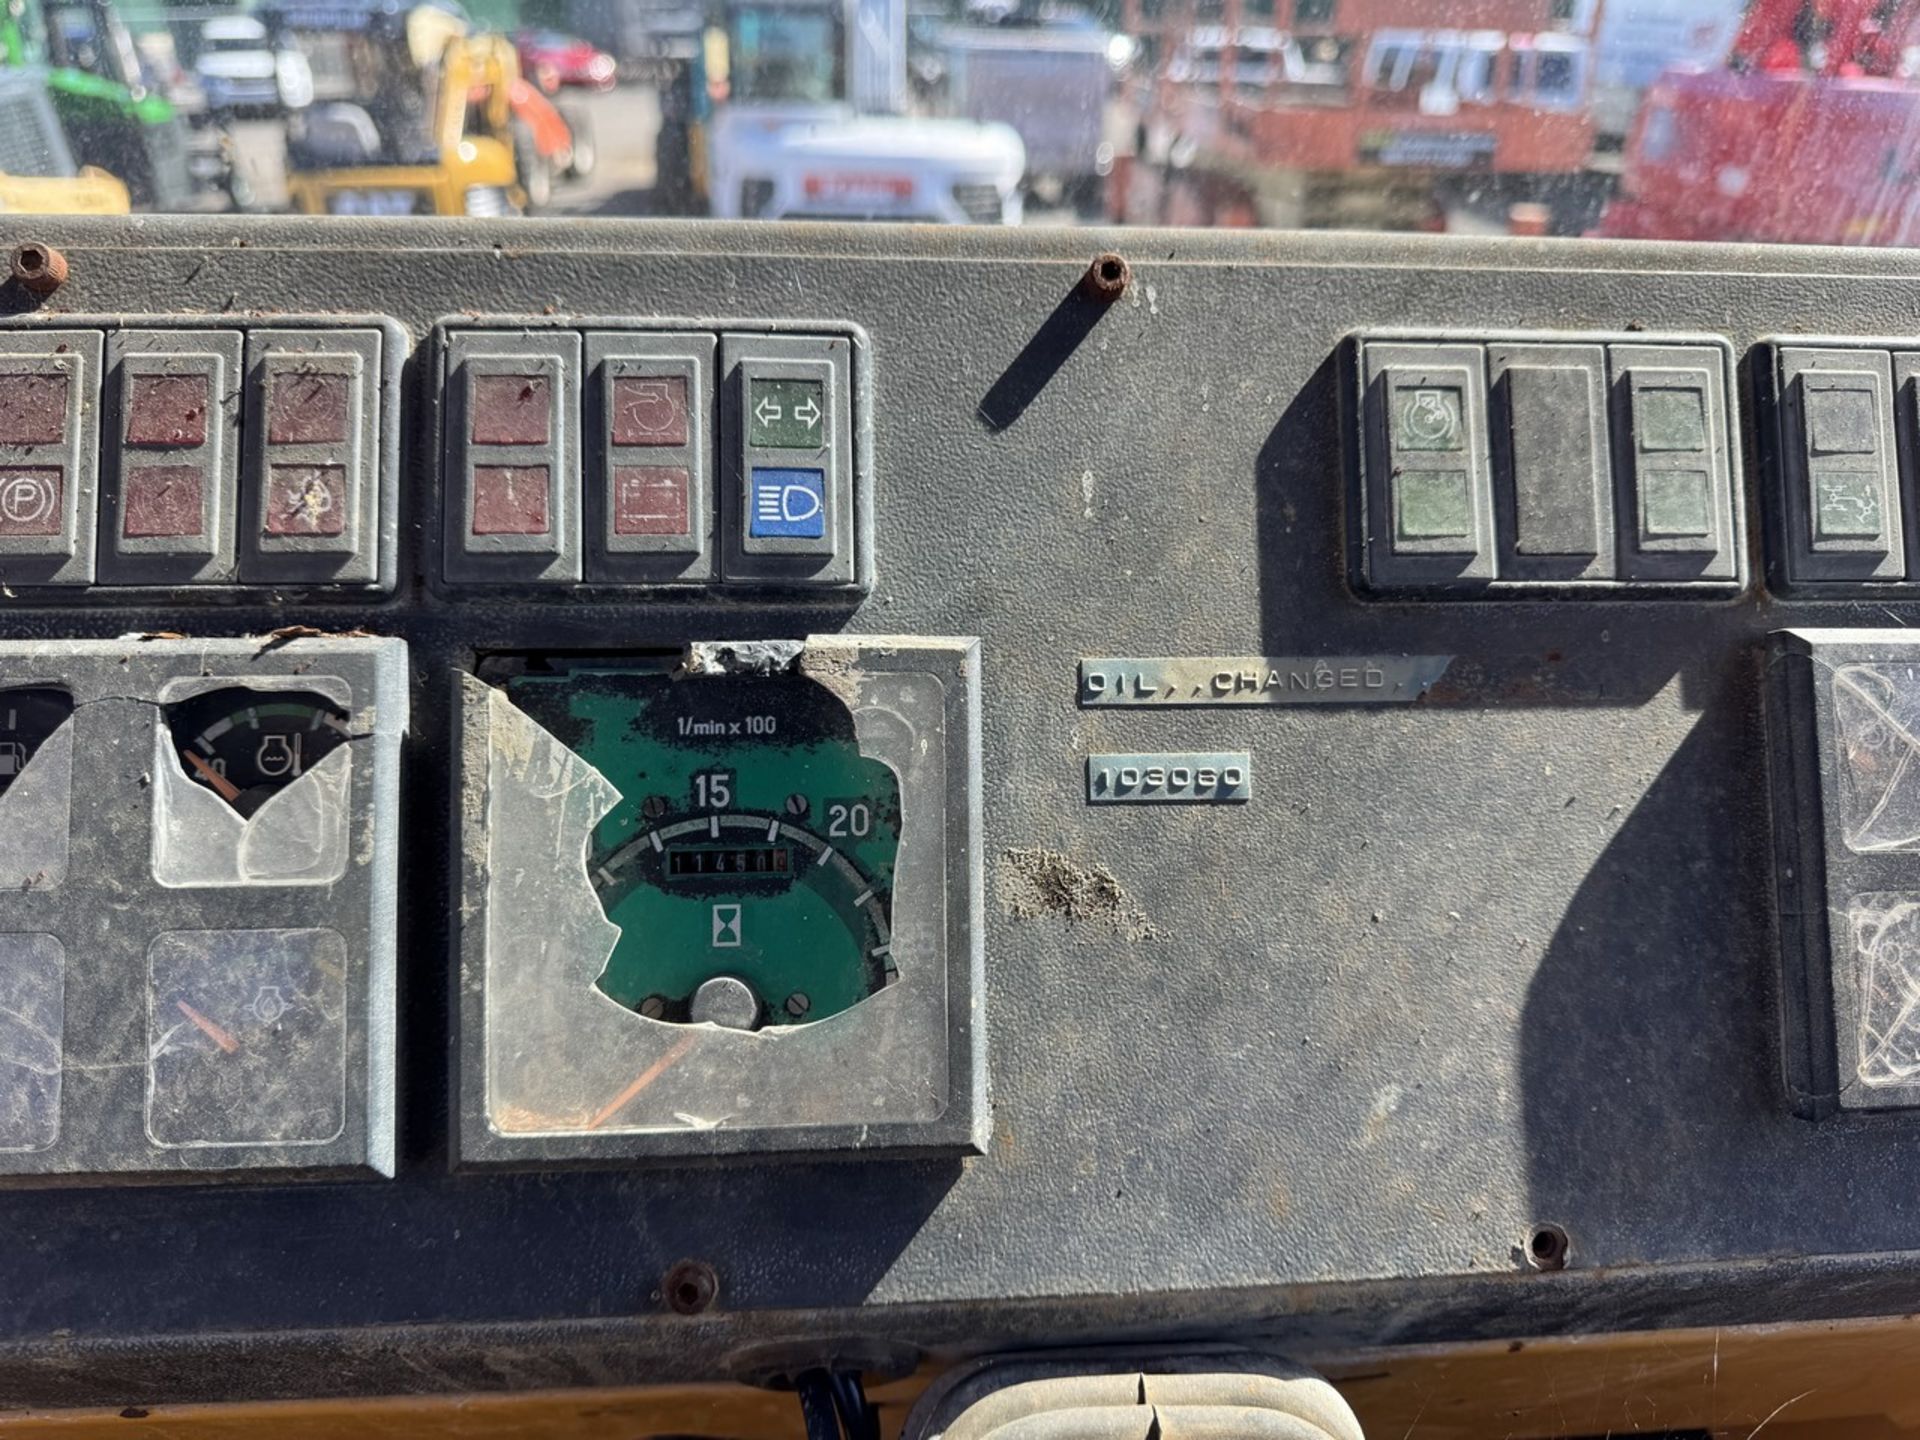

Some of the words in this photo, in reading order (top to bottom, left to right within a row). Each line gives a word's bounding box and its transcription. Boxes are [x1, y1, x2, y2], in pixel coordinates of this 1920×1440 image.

[677, 716, 725, 735] 1/min
[729, 722, 741, 735] x
[745, 715, 776, 734] 100
[695, 774, 730, 808] 15
[829, 803, 869, 837] 20
